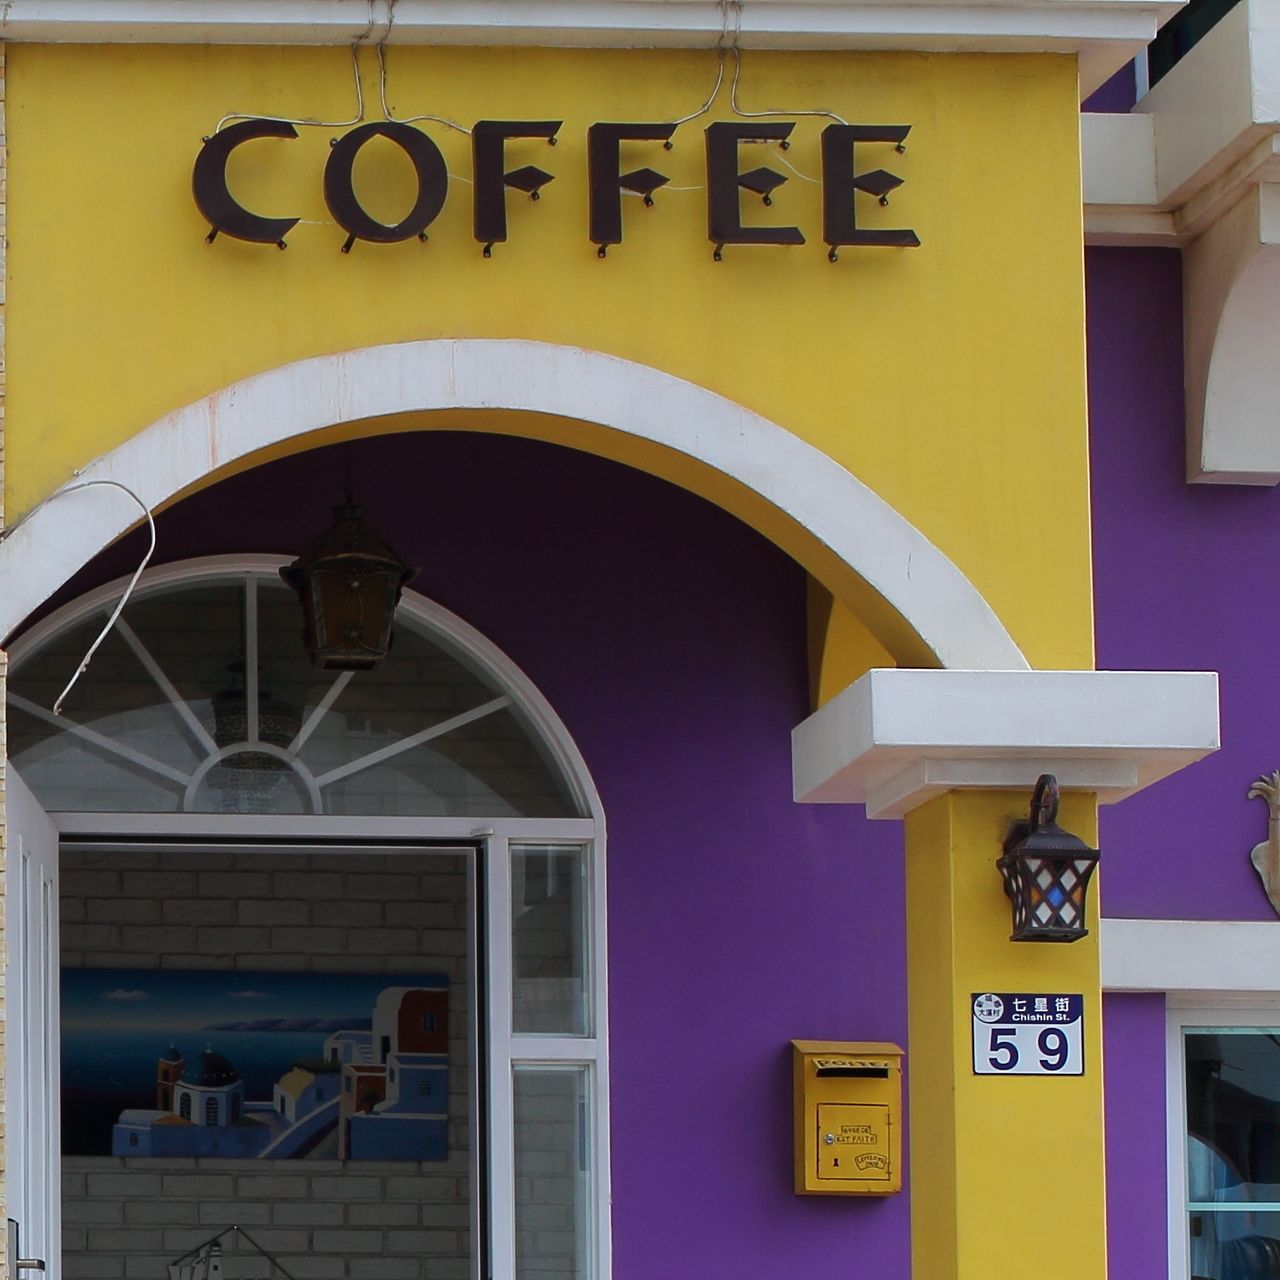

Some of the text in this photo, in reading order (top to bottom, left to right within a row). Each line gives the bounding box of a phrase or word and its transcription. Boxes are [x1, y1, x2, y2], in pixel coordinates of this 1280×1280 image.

[191, 118, 922, 248] COFFEE
[1011, 1013, 1070, 1021] Chishin St.
[1012, 997, 1070, 1012] 七星街
[988, 1027, 1069, 1071] 59
